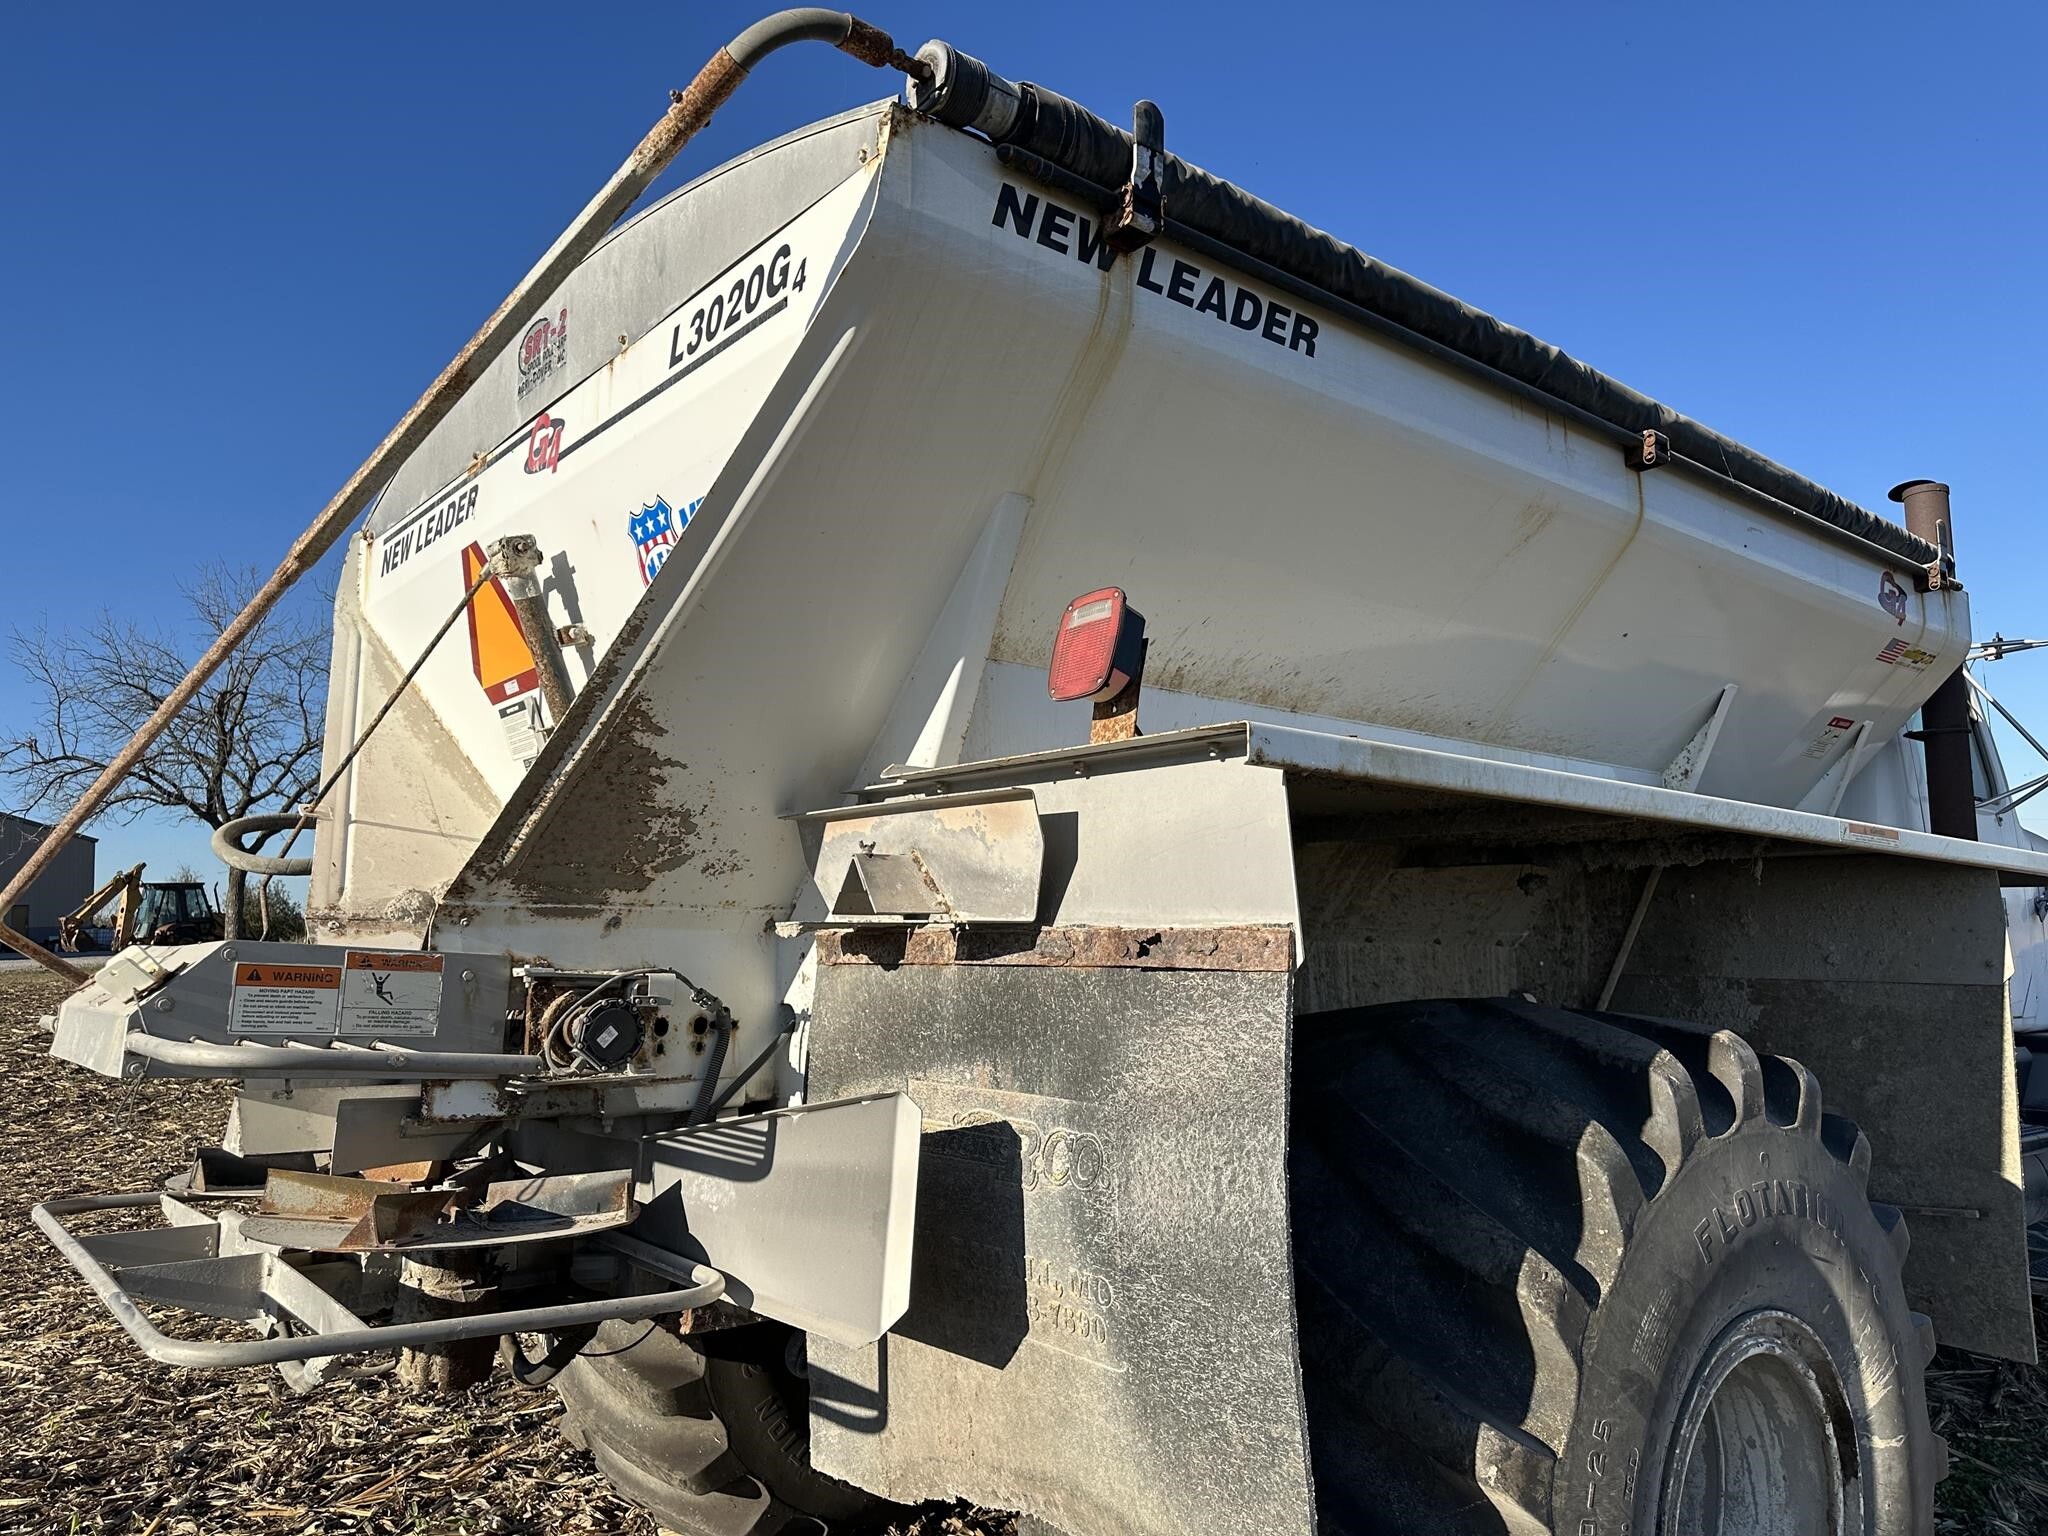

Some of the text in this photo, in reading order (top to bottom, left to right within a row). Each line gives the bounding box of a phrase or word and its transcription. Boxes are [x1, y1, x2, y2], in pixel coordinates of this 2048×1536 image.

[991, 182, 1321, 359] NEW LEADER
[380, 483, 479, 578] NEW LEADER
[273, 971, 334, 983] WARNING
[1692, 1178, 1848, 1265] FLOTATION
